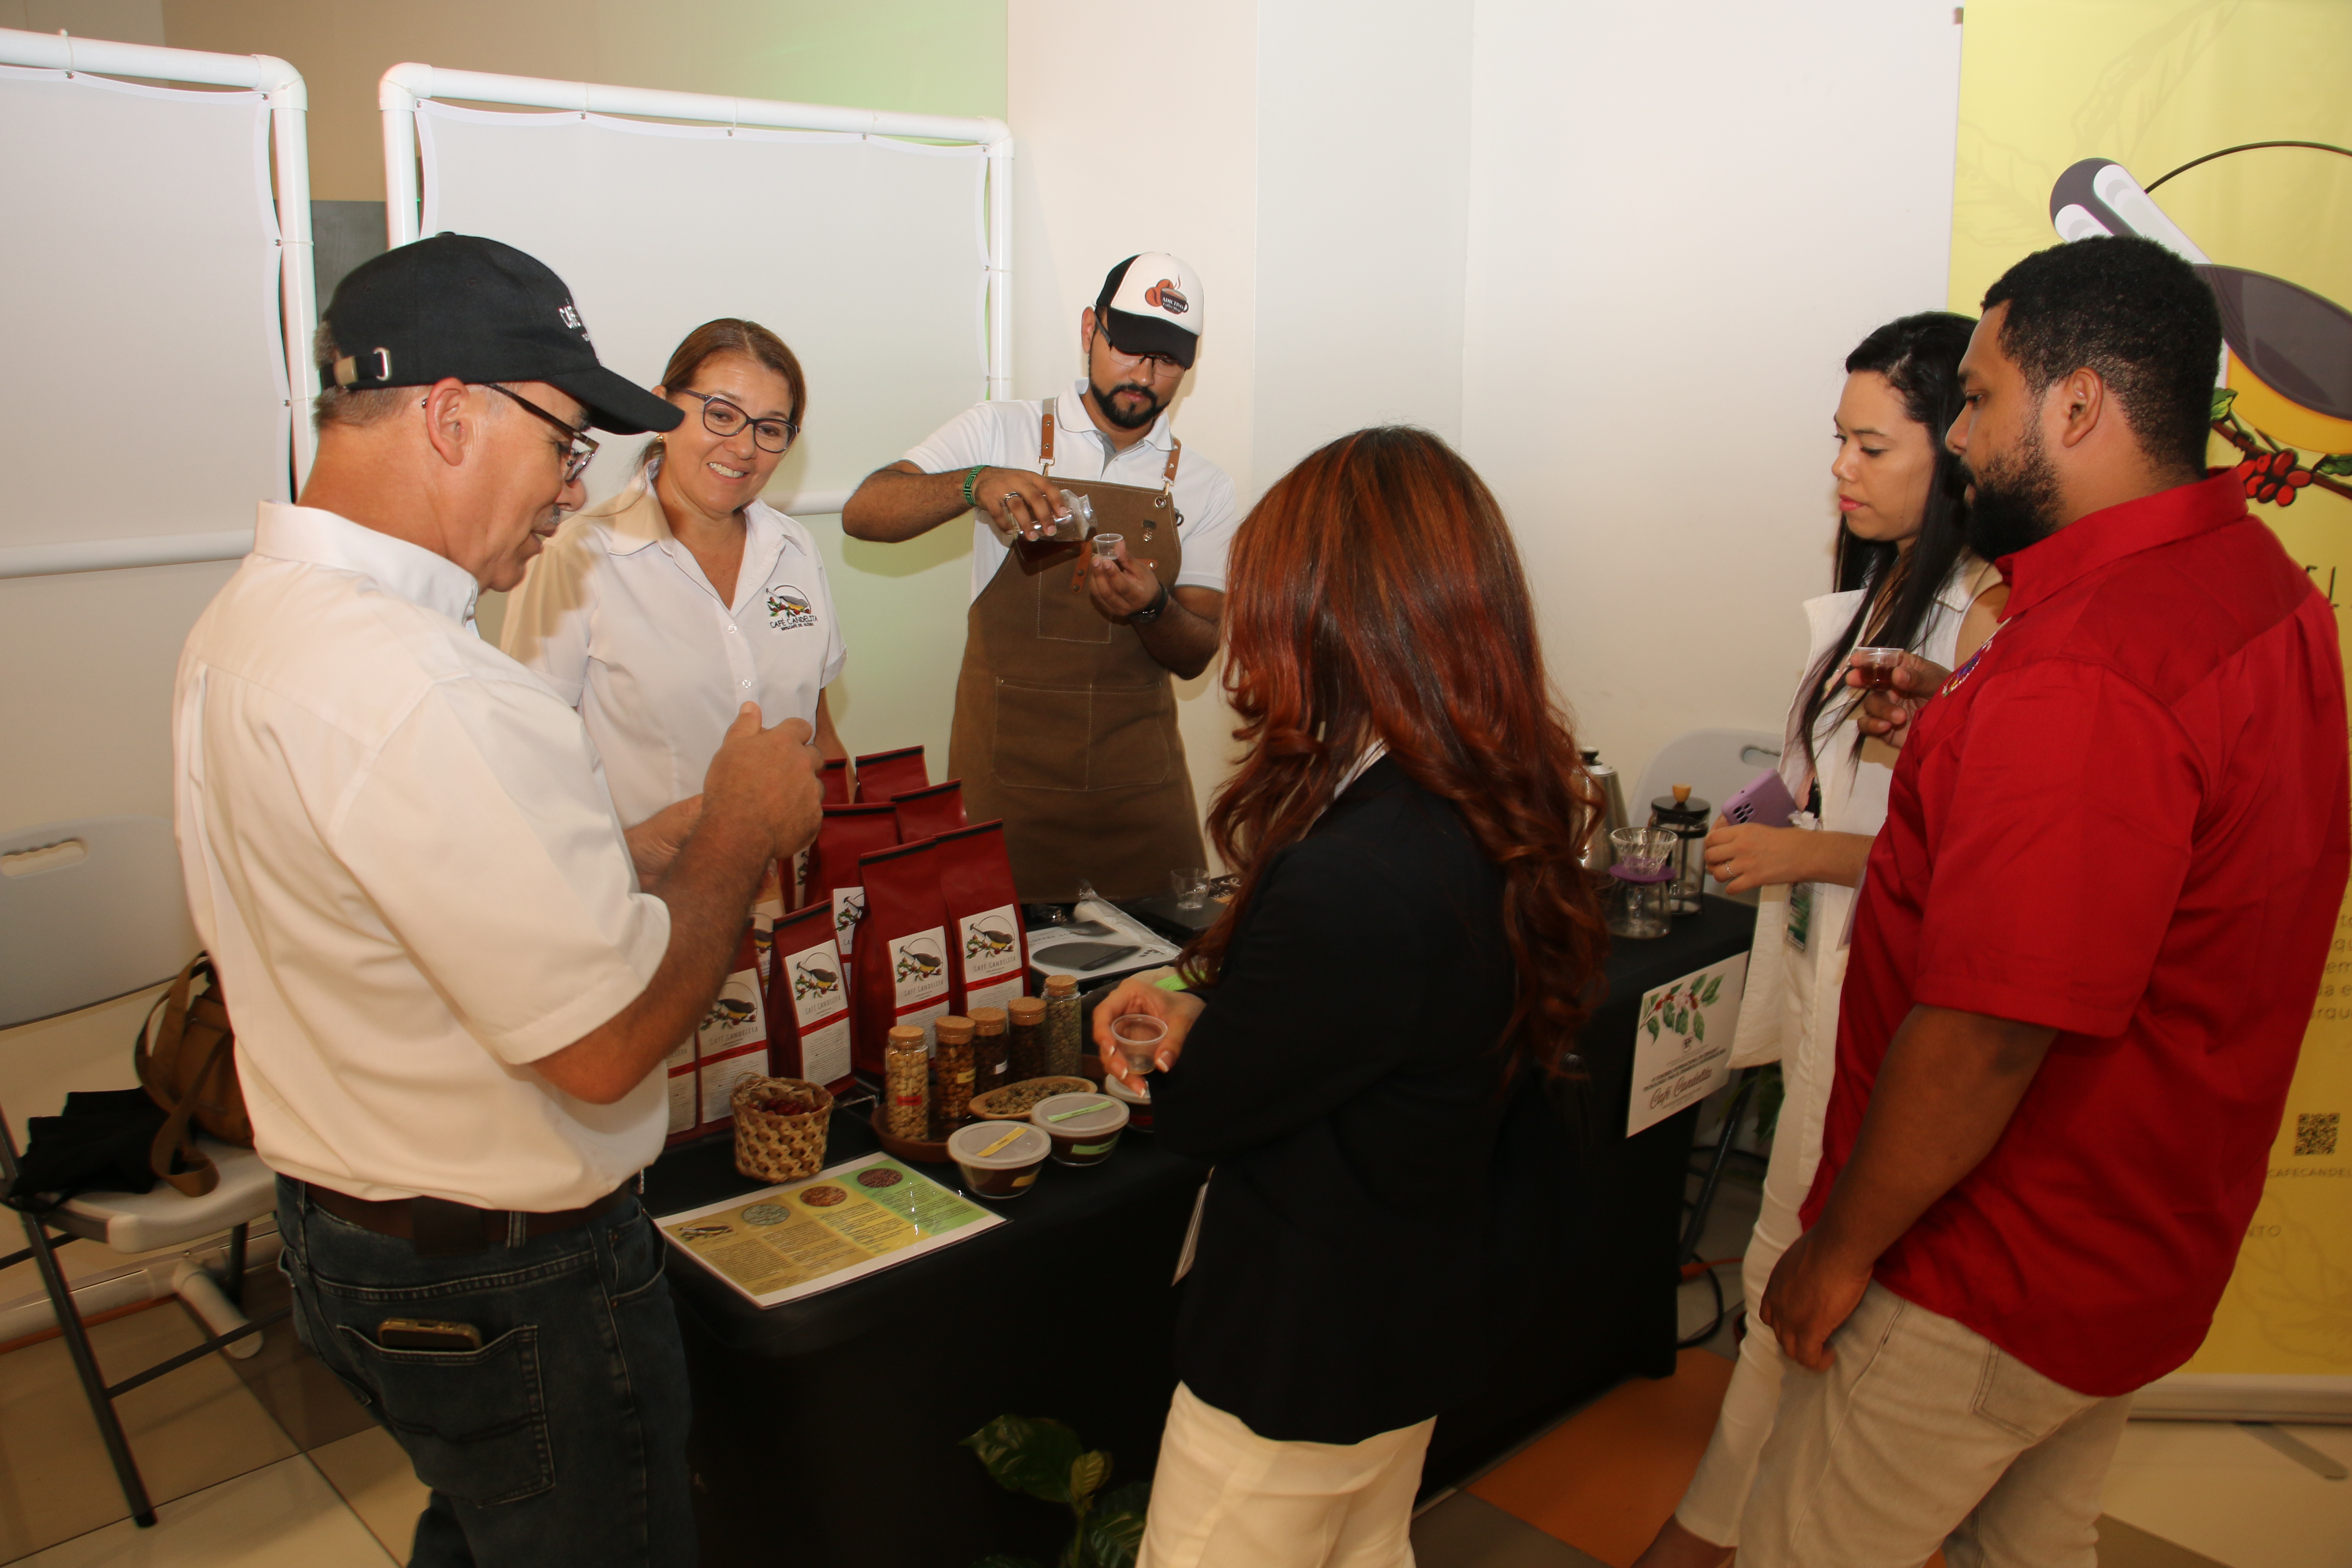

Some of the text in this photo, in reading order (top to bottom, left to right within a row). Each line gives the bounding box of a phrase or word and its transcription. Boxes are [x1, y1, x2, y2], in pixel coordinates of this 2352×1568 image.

[1162, 297, 1183, 309] ADICTIVO
[770, 616, 818, 628] CAFÉ CANDELITA
[989, 955, 1016, 968] CANDELITA
[918, 979, 944, 992] CANDELITA
[818, 995, 841, 1010] CANDELITA
[726, 1026, 759, 1041] CANDELITA
[1650, 1086, 1672, 1110] Café
[1673, 1066, 1713, 1098] Candelita
